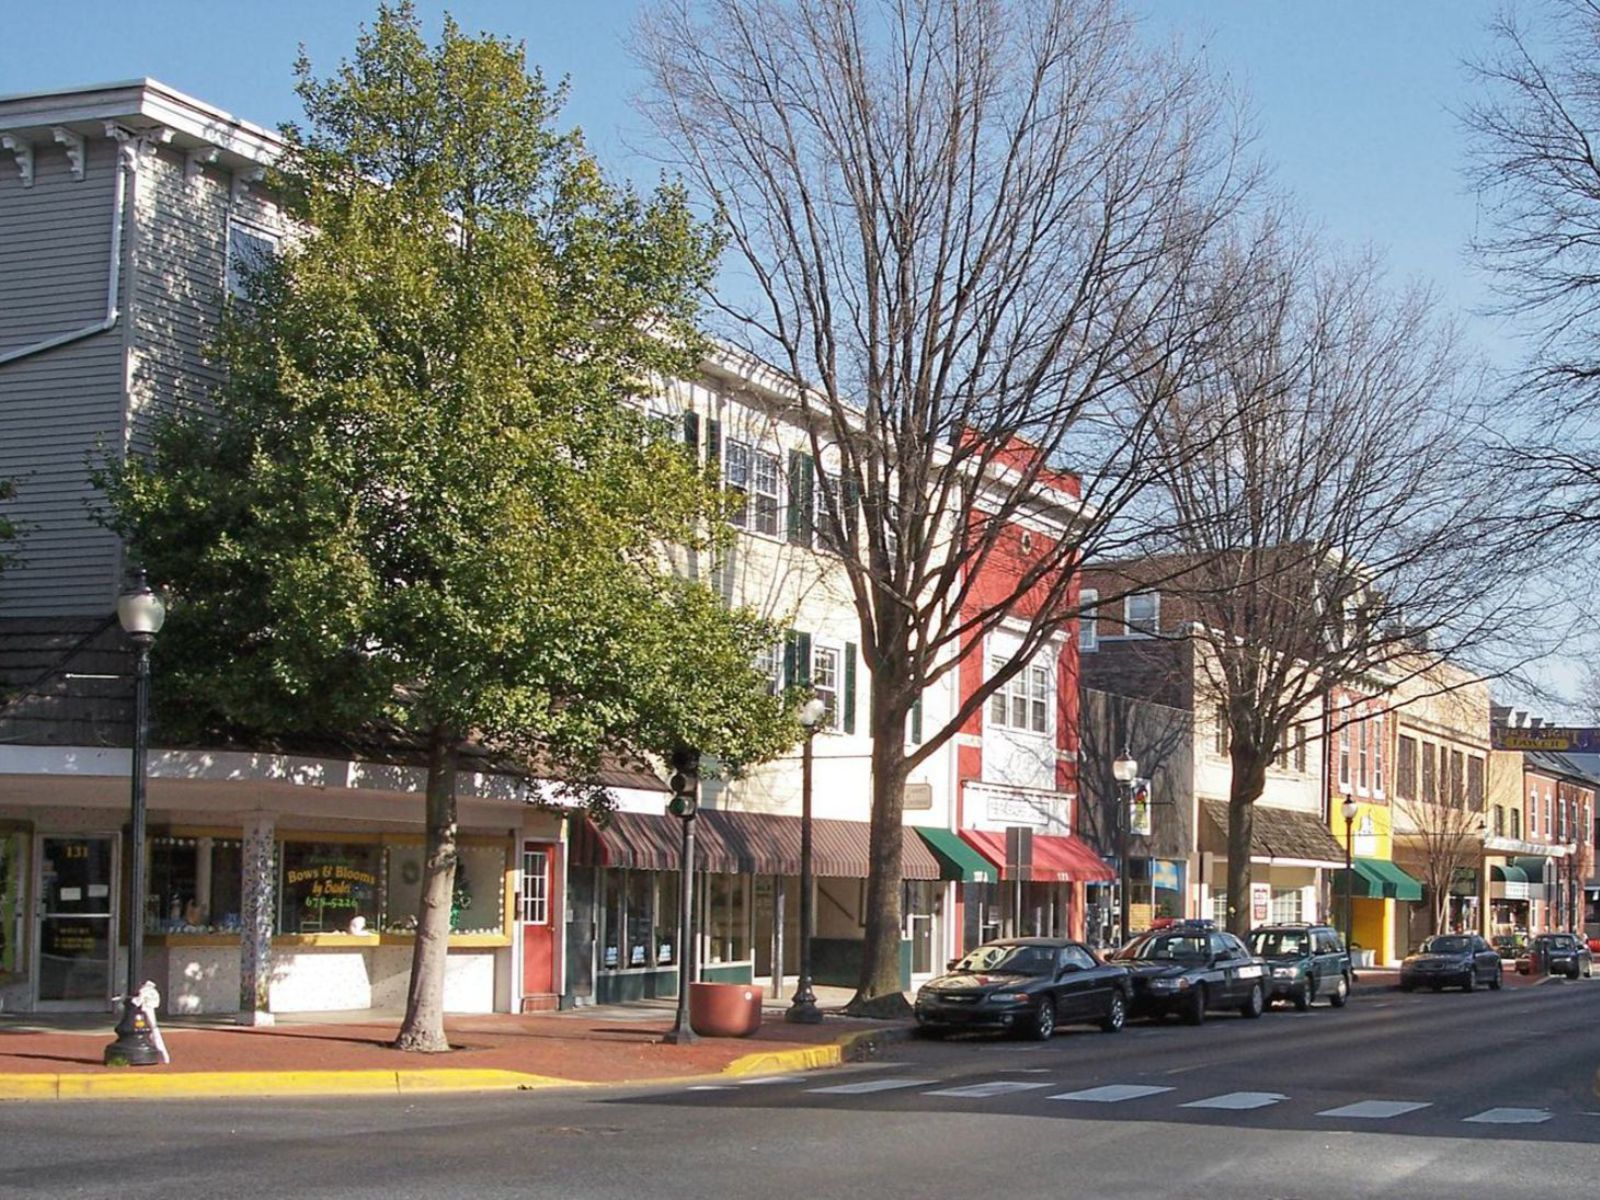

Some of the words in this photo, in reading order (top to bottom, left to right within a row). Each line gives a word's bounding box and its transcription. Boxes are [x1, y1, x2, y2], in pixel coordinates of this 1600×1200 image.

[65, 846, 88, 858] 131
[287, 869, 319, 884] Bows
[321, 865, 333, 878] &
[335, 866, 376, 885] Blooms
